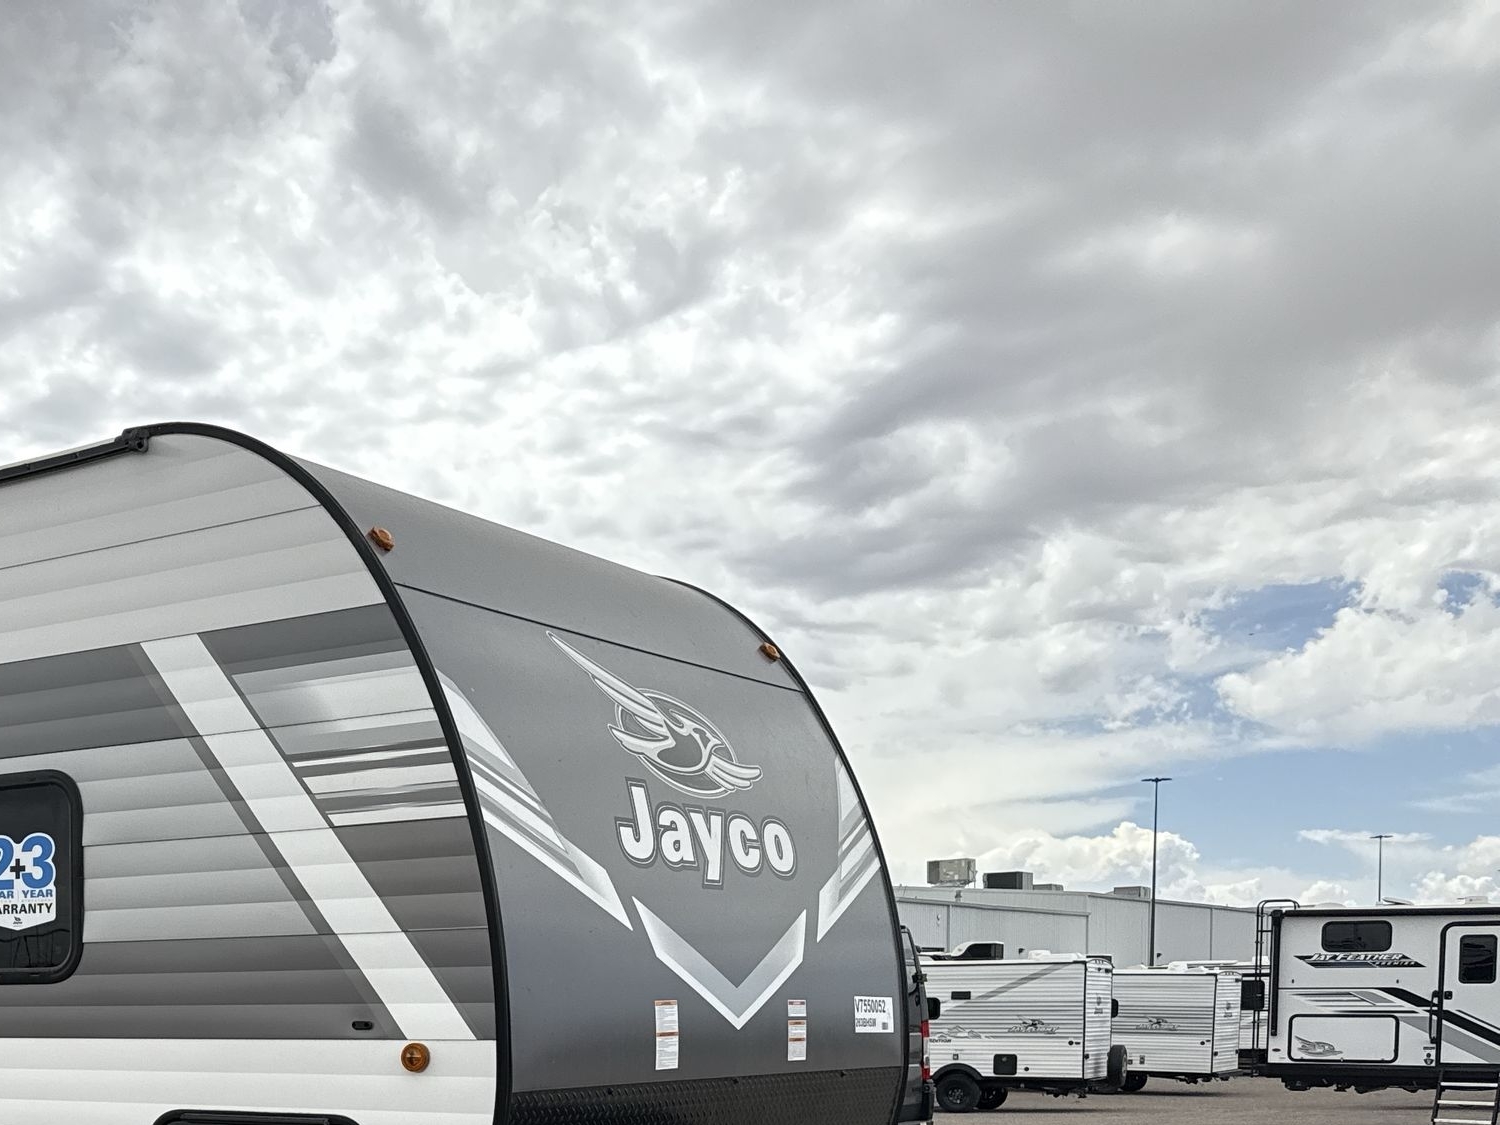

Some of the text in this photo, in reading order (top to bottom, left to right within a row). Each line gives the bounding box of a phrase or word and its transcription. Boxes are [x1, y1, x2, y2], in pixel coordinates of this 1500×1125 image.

[616, 780, 797, 886] Jayco
[21, 888, 53, 898] YEAR
[1310, 952, 1404, 961] JAY FEATHER
